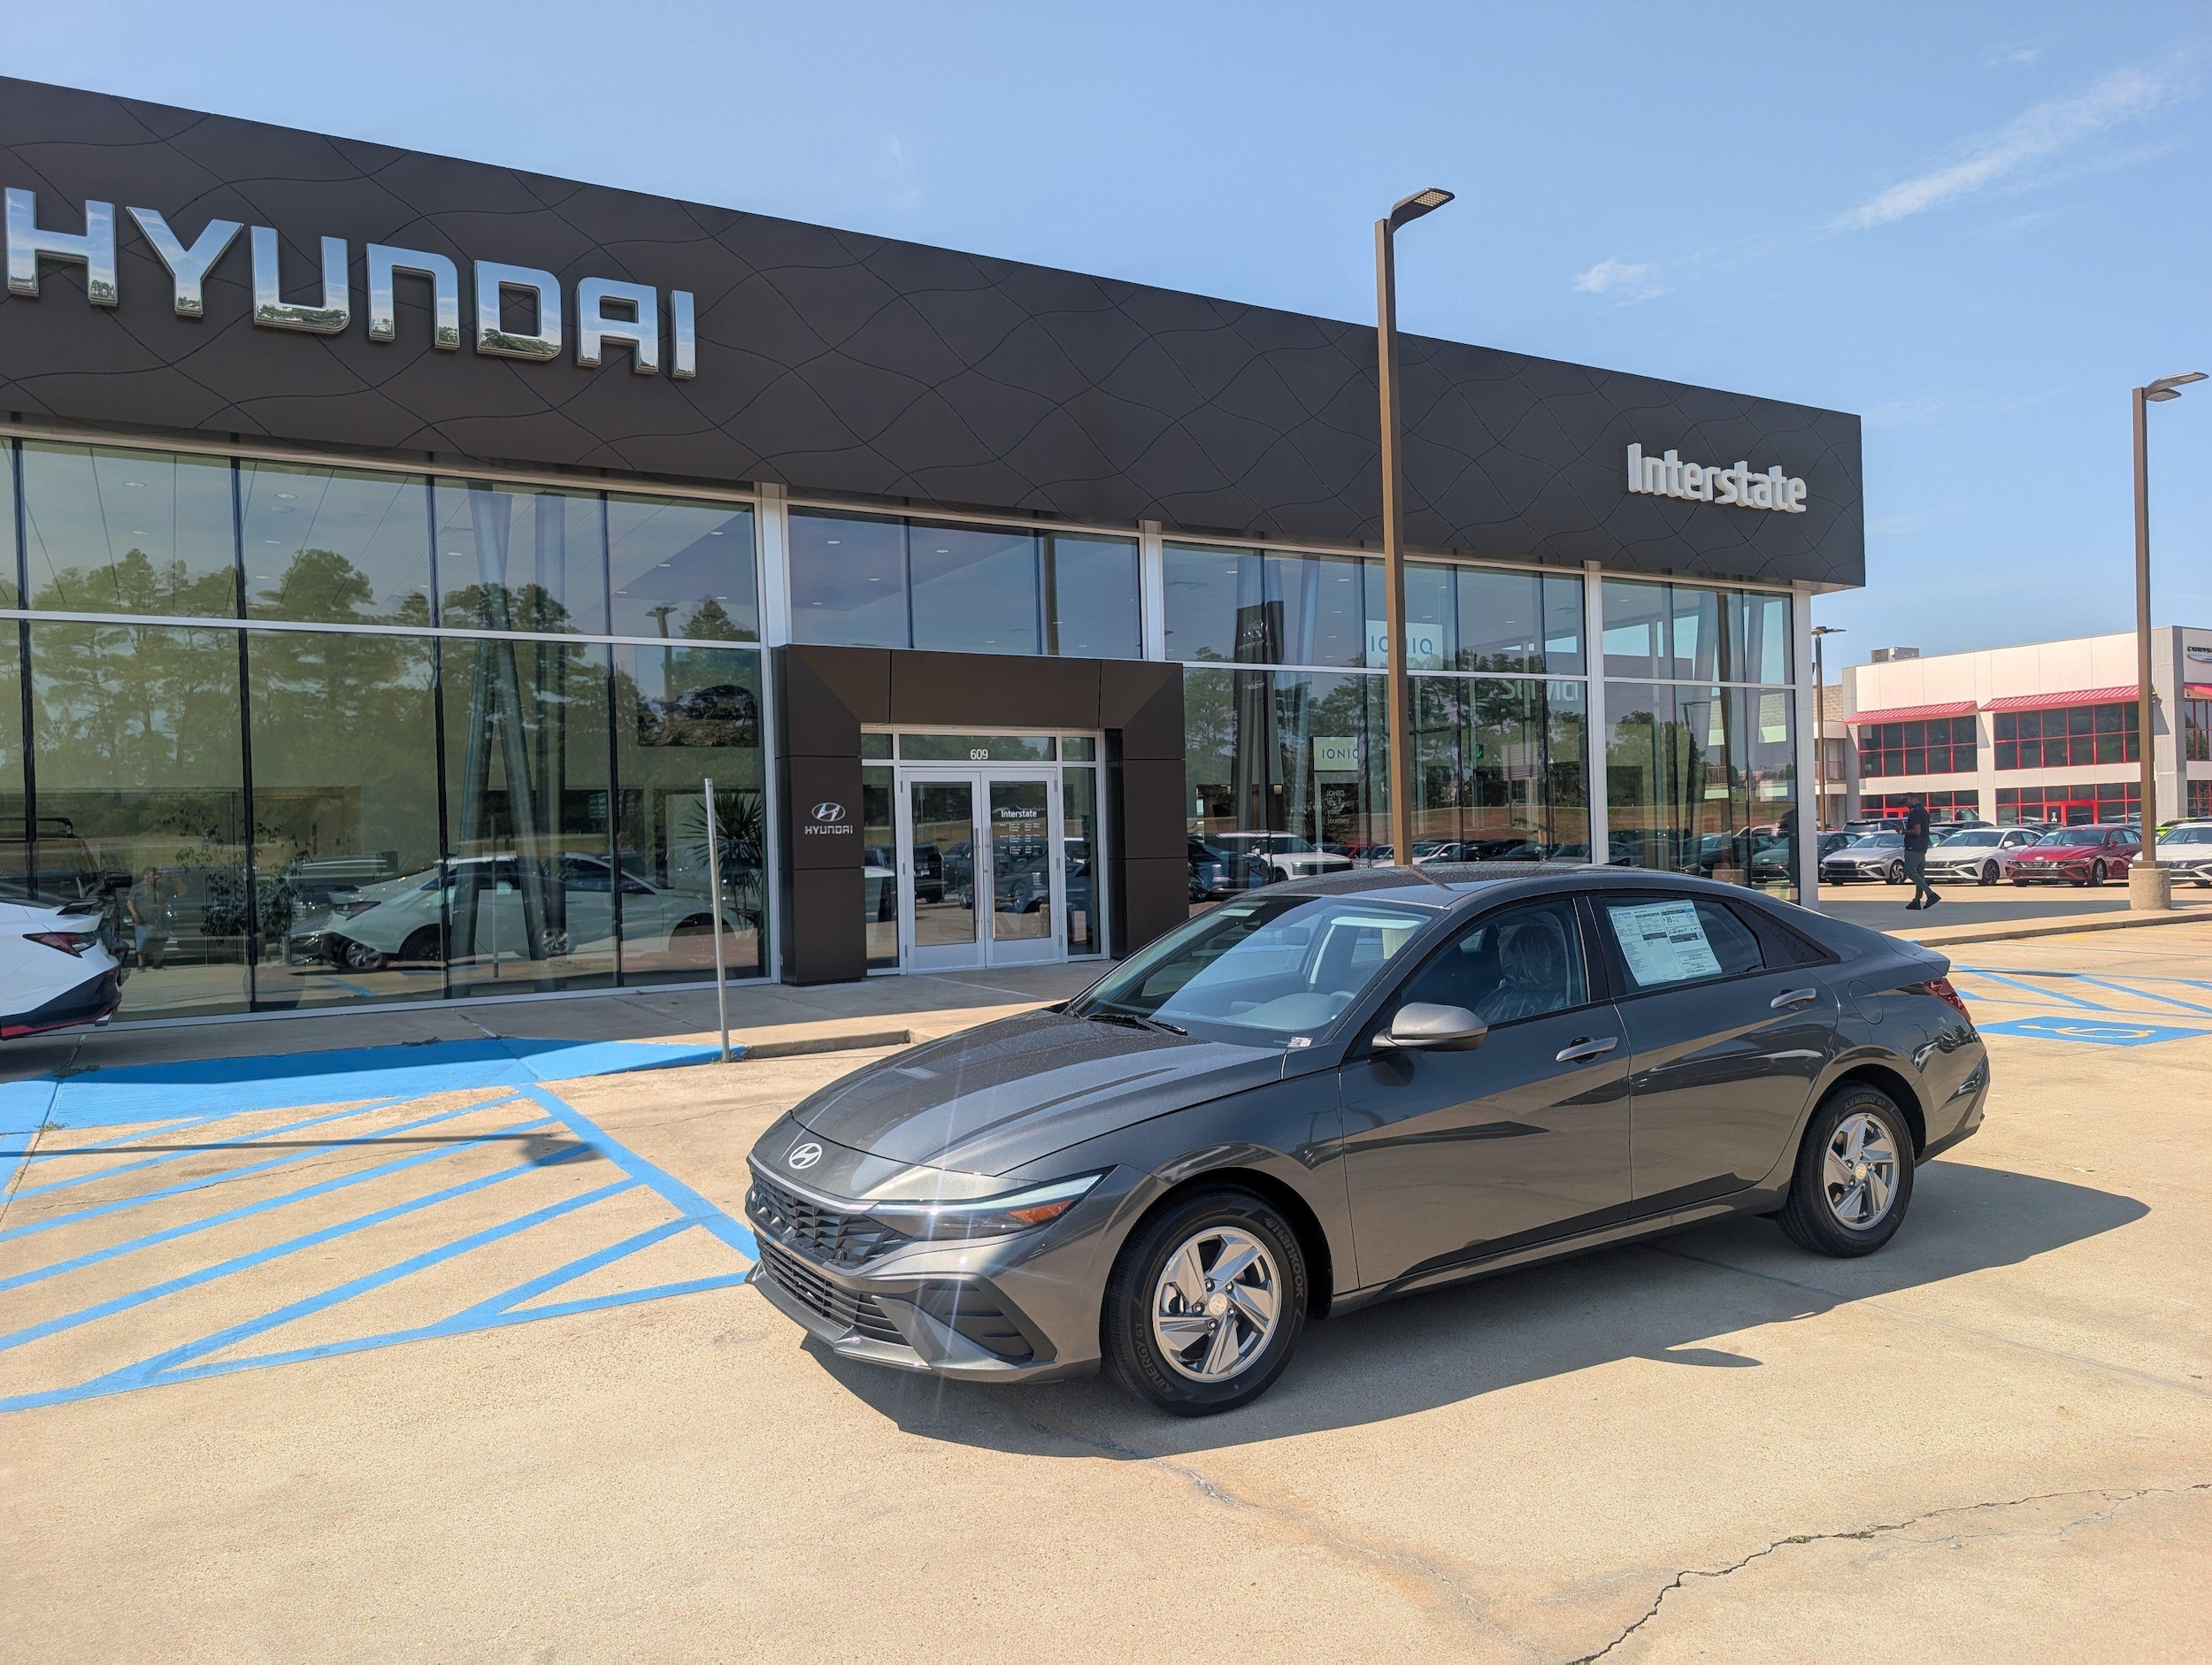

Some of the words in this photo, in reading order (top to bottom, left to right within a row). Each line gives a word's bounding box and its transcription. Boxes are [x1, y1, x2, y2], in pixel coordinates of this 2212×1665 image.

[5, 188, 696, 379] HYUNDAI
[1627, 442, 1807, 513] Interstate
[1371, 635, 1433, 655] IOIQ
[970, 748, 988, 760] 609
[1001, 809, 1038, 818] Interstate
[804, 825, 854, 835] HYUNDAI
[1135, 1321, 1143, 1338] GT
[1135, 1339, 1174, 1393] KINERGY
